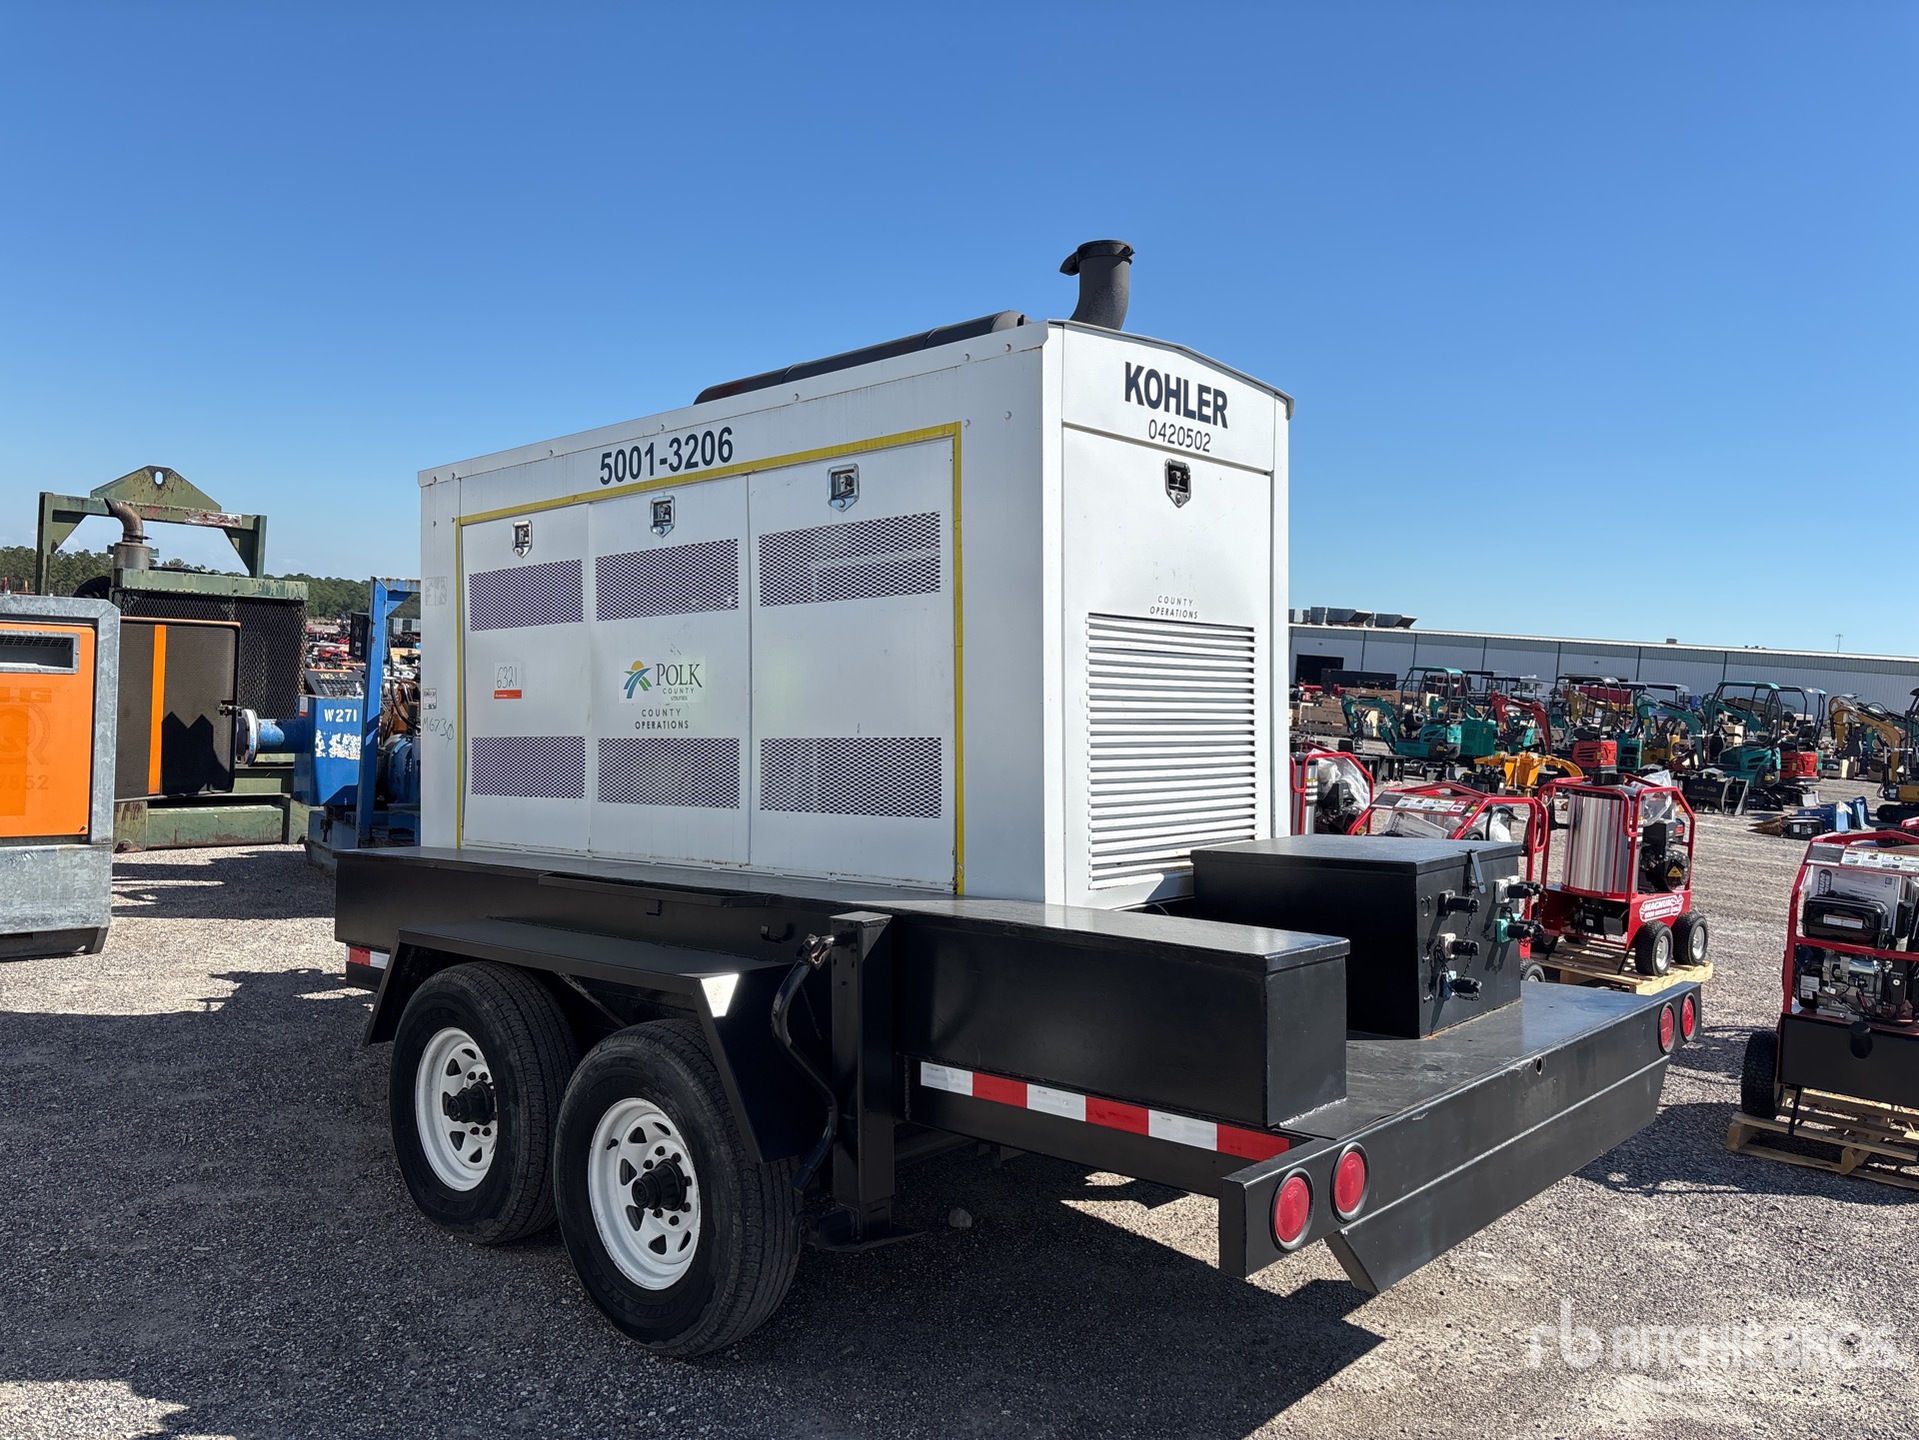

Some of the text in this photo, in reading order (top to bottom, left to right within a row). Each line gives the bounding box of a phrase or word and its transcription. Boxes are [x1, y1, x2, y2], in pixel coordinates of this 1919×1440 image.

[1125, 361, 1229, 429] KOHLER
[1148, 419, 1211, 453] 0420502
[600, 426, 733, 485] 5001-3206
[1157, 595, 1194, 607] COUNTY
[1149, 606, 1198, 619] OPERATIONS
[656, 663, 703, 688] POLK
[662, 687, 694, 695] COUNTY
[641, 708, 681, 717] COUNTY
[634, 720, 689, 730] OPERATIONS
